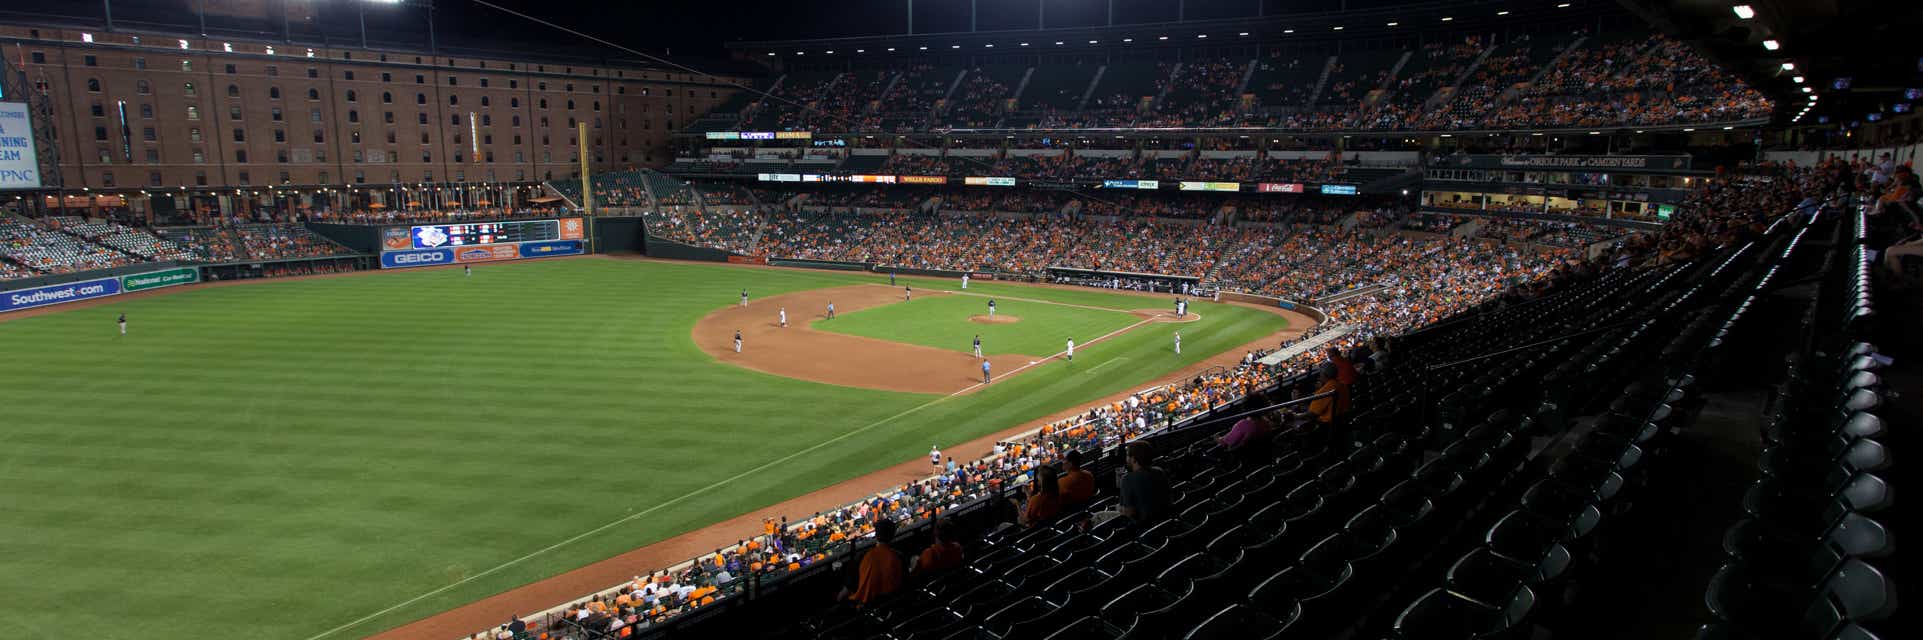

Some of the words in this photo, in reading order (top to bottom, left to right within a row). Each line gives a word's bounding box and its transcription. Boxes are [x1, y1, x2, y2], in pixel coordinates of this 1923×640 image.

[0, 137, 27, 147] NING
[1560, 158, 1580, 167] PARK
[1, 170, 32, 181] PNC
[395, 252, 444, 264] GEICO
